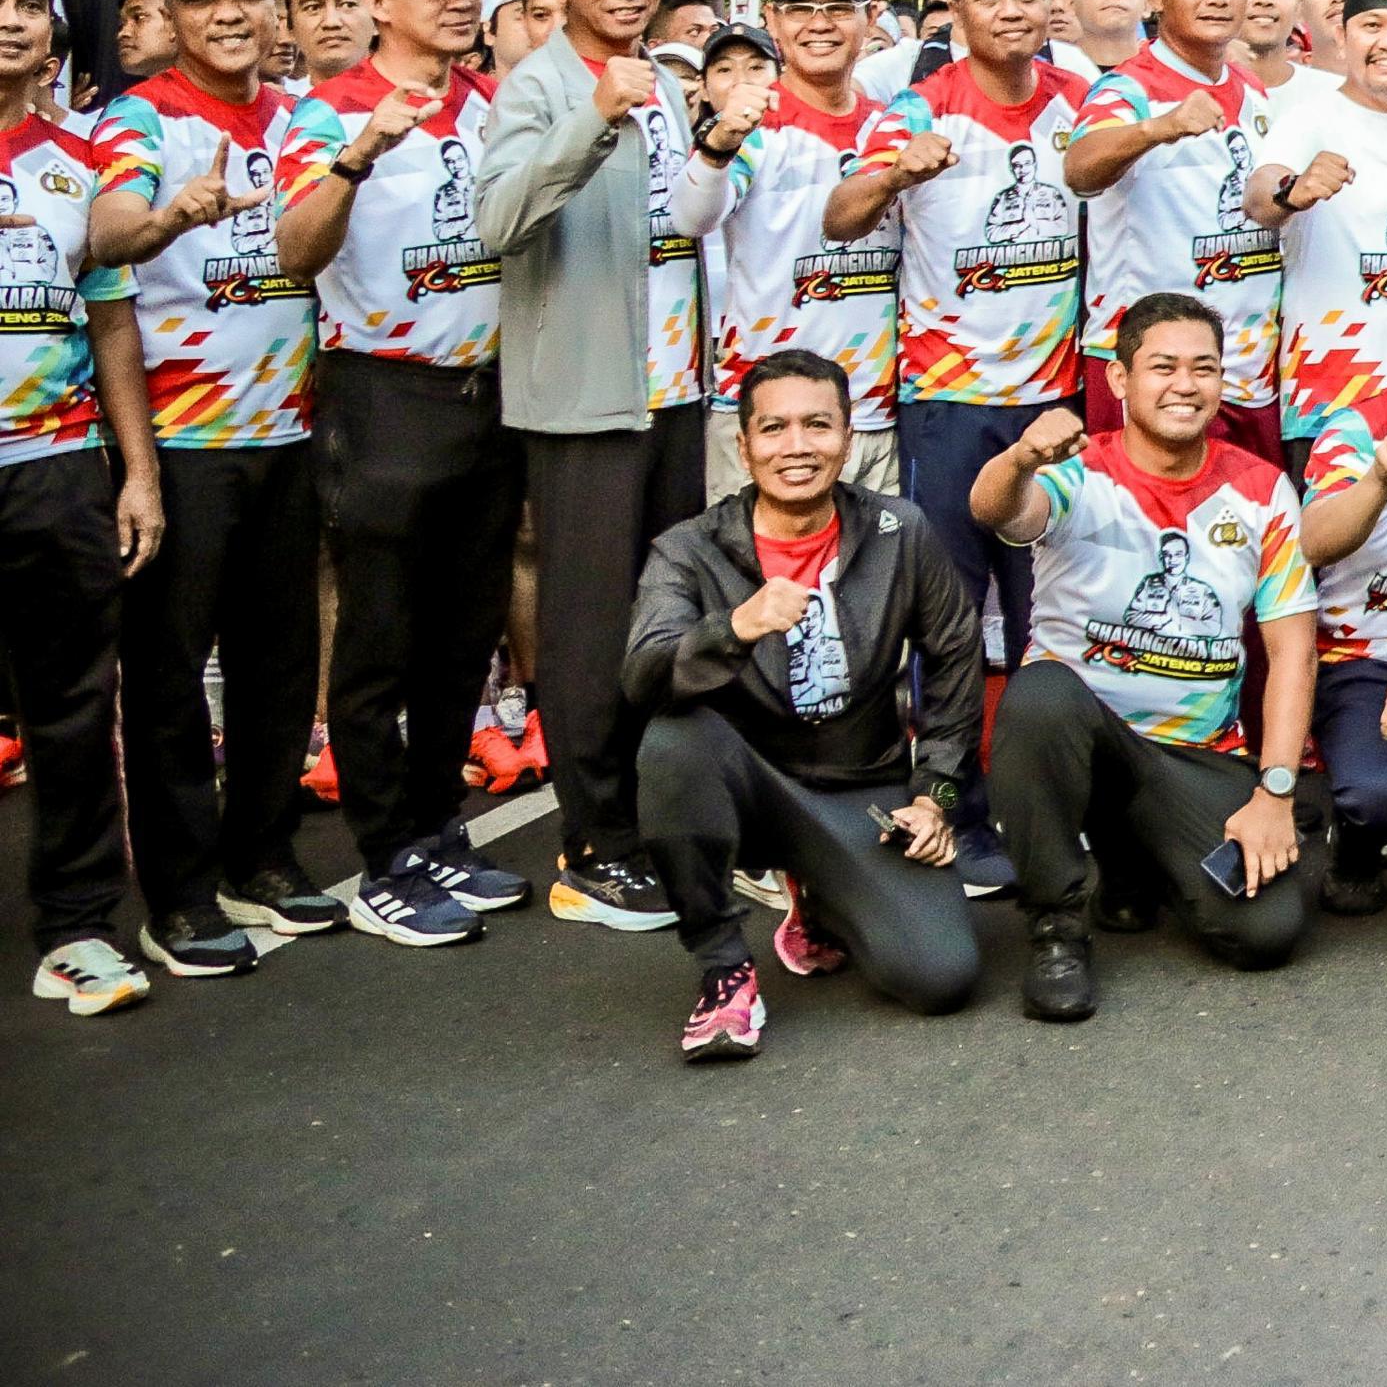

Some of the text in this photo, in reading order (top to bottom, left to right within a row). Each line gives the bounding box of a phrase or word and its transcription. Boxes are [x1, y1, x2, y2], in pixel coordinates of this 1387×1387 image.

[1008, 263, 1060, 279] JATENG
[1087, 620, 1207, 657] BHAYANGKARA
[1141, 653, 1201, 671] JATENG
